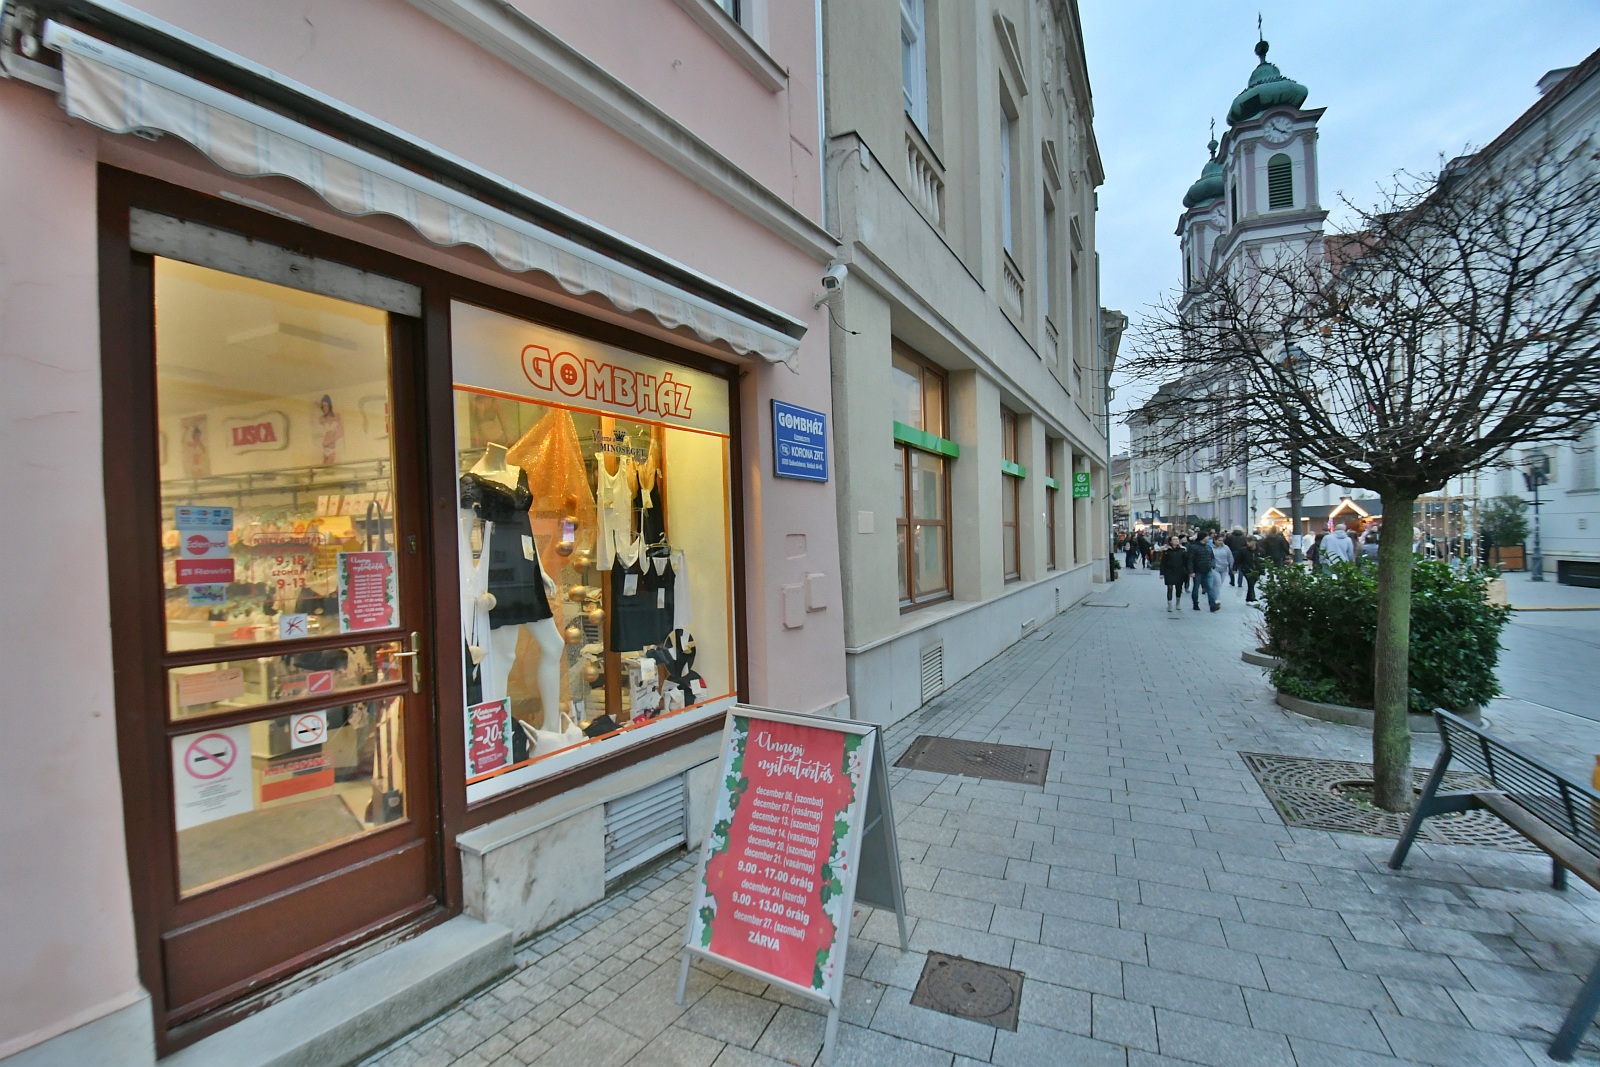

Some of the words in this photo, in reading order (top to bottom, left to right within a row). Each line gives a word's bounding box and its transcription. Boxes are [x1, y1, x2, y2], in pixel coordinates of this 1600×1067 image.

[521, 344, 692, 419] GOMBHÁZ
[778, 411, 823, 436] GOMBHÁZ
[791, 446, 813, 460] KORONA
[754, 731, 804, 761] Ünnepi
[758, 755, 834, 784] nyitvatartás
[753, 798, 781, 811] december
[781, 803, 790, 813] 07.
[791, 805, 823, 822] (vasárnap)
[756, 786, 784, 799] december
[785, 791, 793, 801] 06.
[794, 793, 824, 809] (szombat)
[748, 822, 777, 836] december
[778, 829, 786, 838] 14.
[787, 830, 819, 848] (vasárnap)
[751, 810, 780, 823] december
[781, 816, 789, 826] 13.
[790, 818, 820, 834] (szombat)
[744, 847, 773, 861] december
[773, 854, 782, 864] 21.
[783, 857, 815, 875] (vasárnap)
[747, 835, 776, 848] december
[776, 841, 785, 852] 20.
[786, 844, 816, 861] (szombat)
[737, 860, 757, 874] 9.00
[764, 867, 788, 883] 17.00
[789, 874, 814, 893] óráig
[741, 879, 771, 894] december
[771, 886, 781, 898] 24.
[781, 889, 806, 907] (szerda)
[732, 891, 751, 906] 9.00
[759, 899, 784, 915] 13.00
[785, 906, 810, 926] óráig
[733, 909, 763, 926] december
[763, 917, 772, 930] 27.
[773, 920, 806, 941] (szombat)
[747, 930, 780, 951] ZÁRVA
